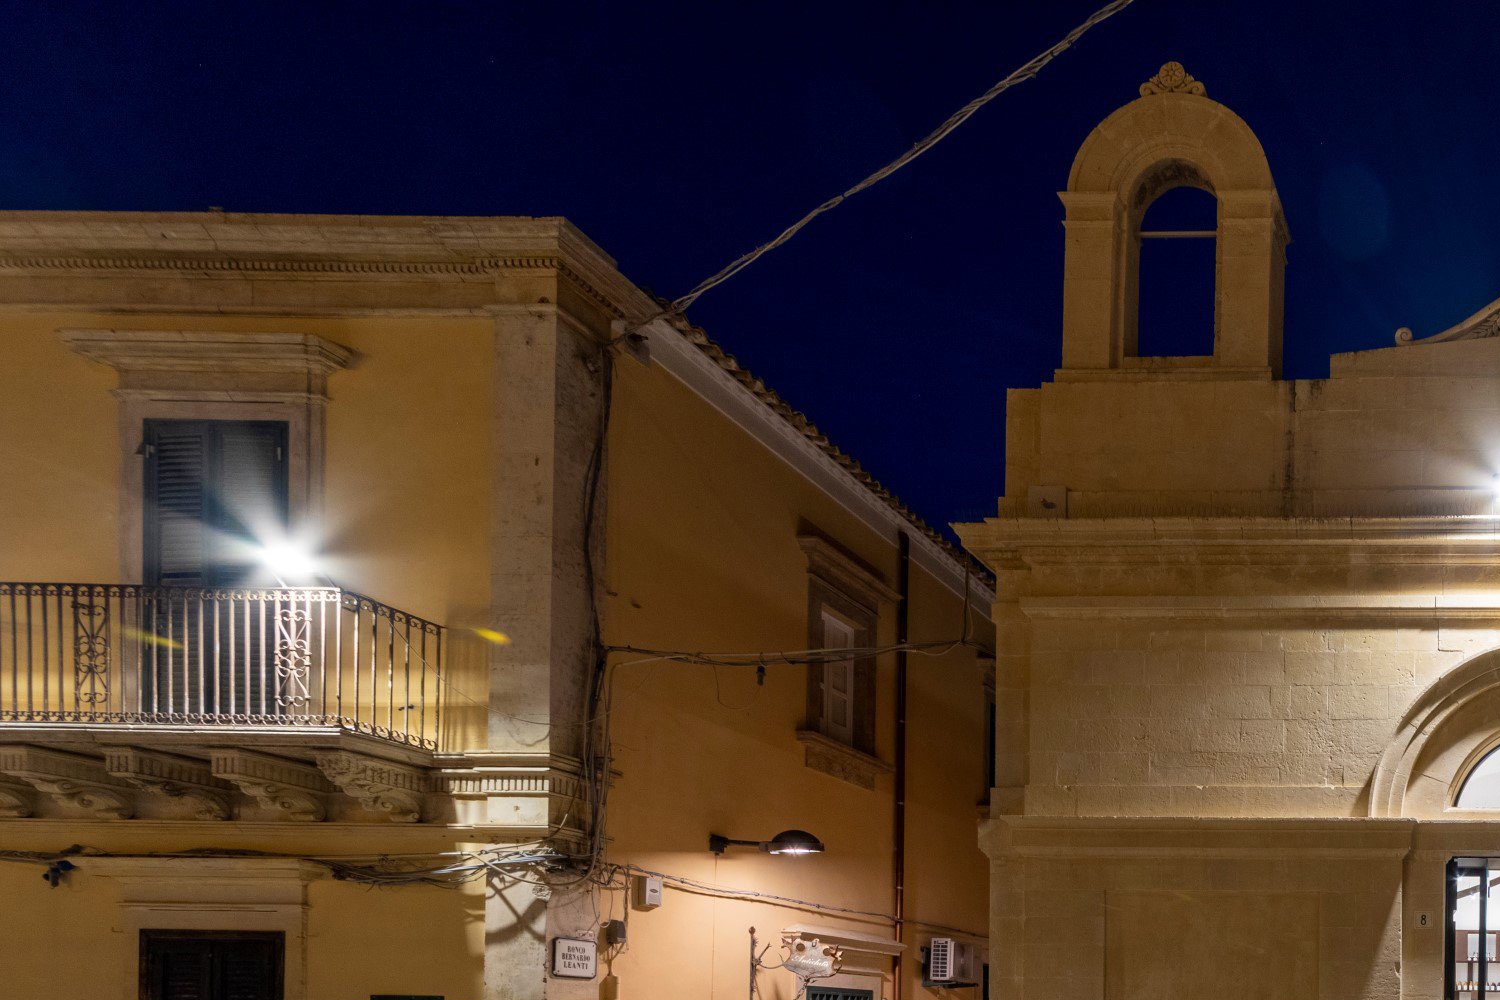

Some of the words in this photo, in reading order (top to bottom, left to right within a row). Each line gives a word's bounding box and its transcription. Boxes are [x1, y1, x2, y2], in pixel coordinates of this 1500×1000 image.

[1420, 914, 1427, 926] 8
[561, 952, 591, 963] BERNARDO
[563, 961, 589, 970] LEANTI
